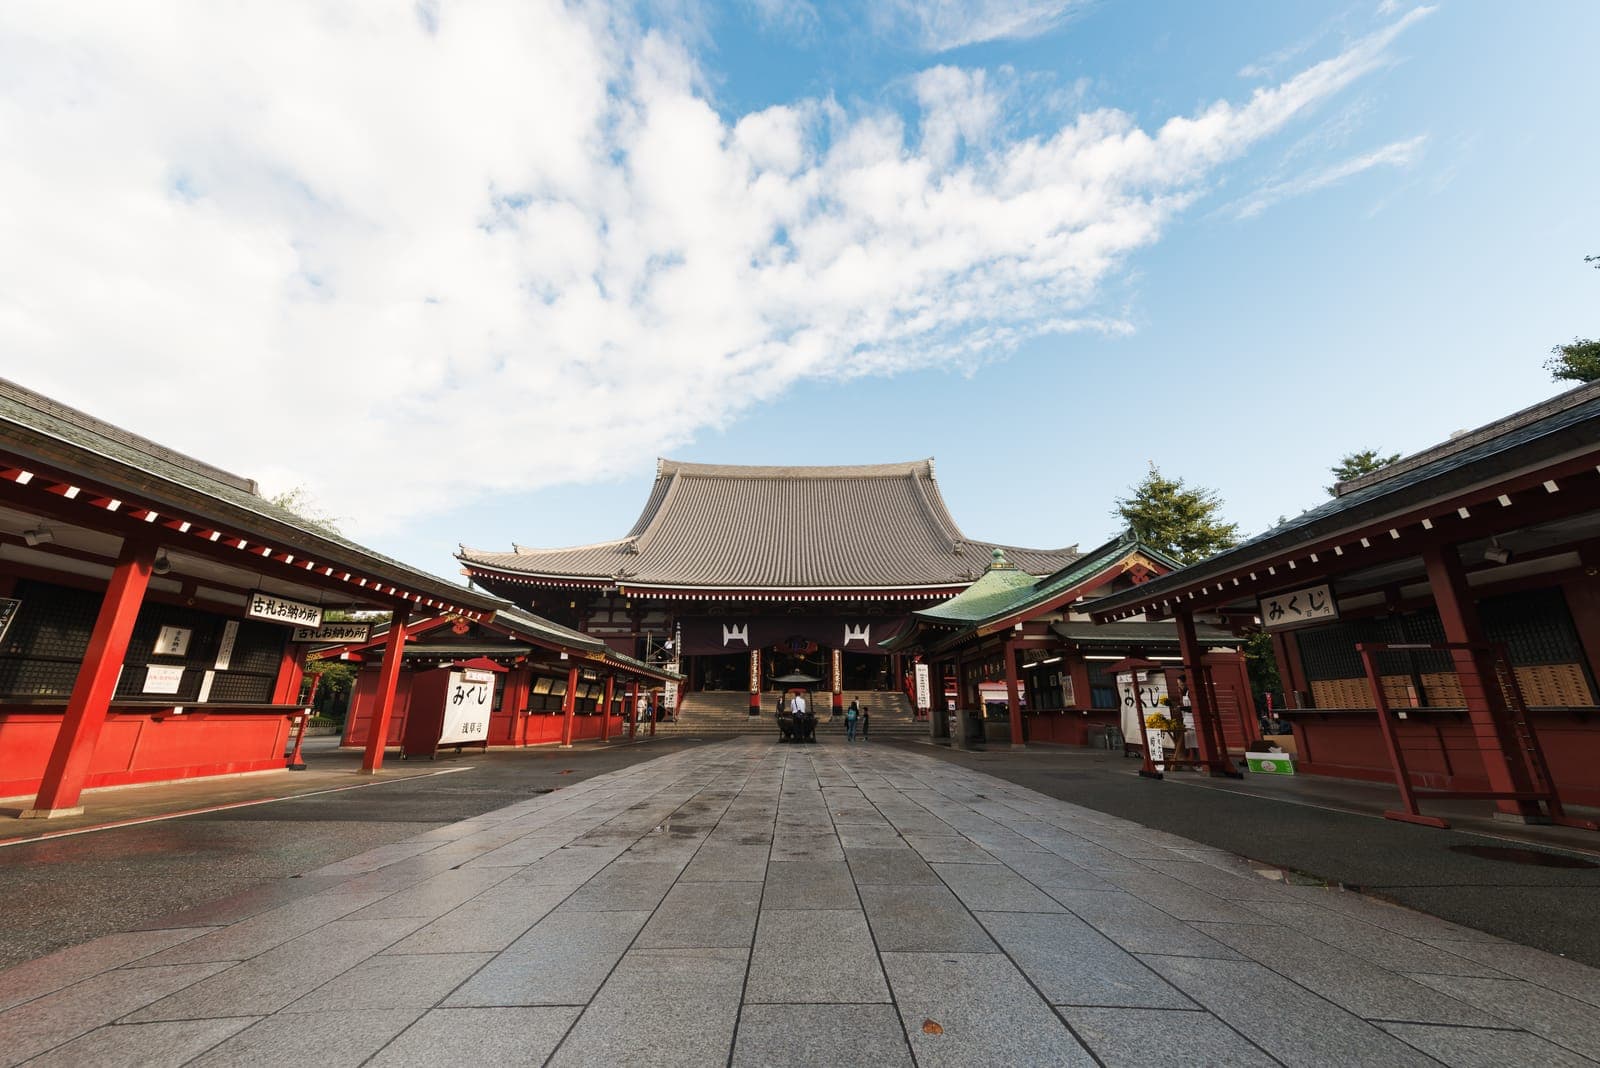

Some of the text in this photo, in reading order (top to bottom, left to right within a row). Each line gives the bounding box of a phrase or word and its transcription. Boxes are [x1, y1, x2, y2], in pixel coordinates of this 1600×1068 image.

[253, 597, 318, 622] 古札お納め所
[1269, 591, 1325, 620] みくじ
[298, 626, 366, 639] 古札お納め所
[453, 685, 488, 705] みくじ
